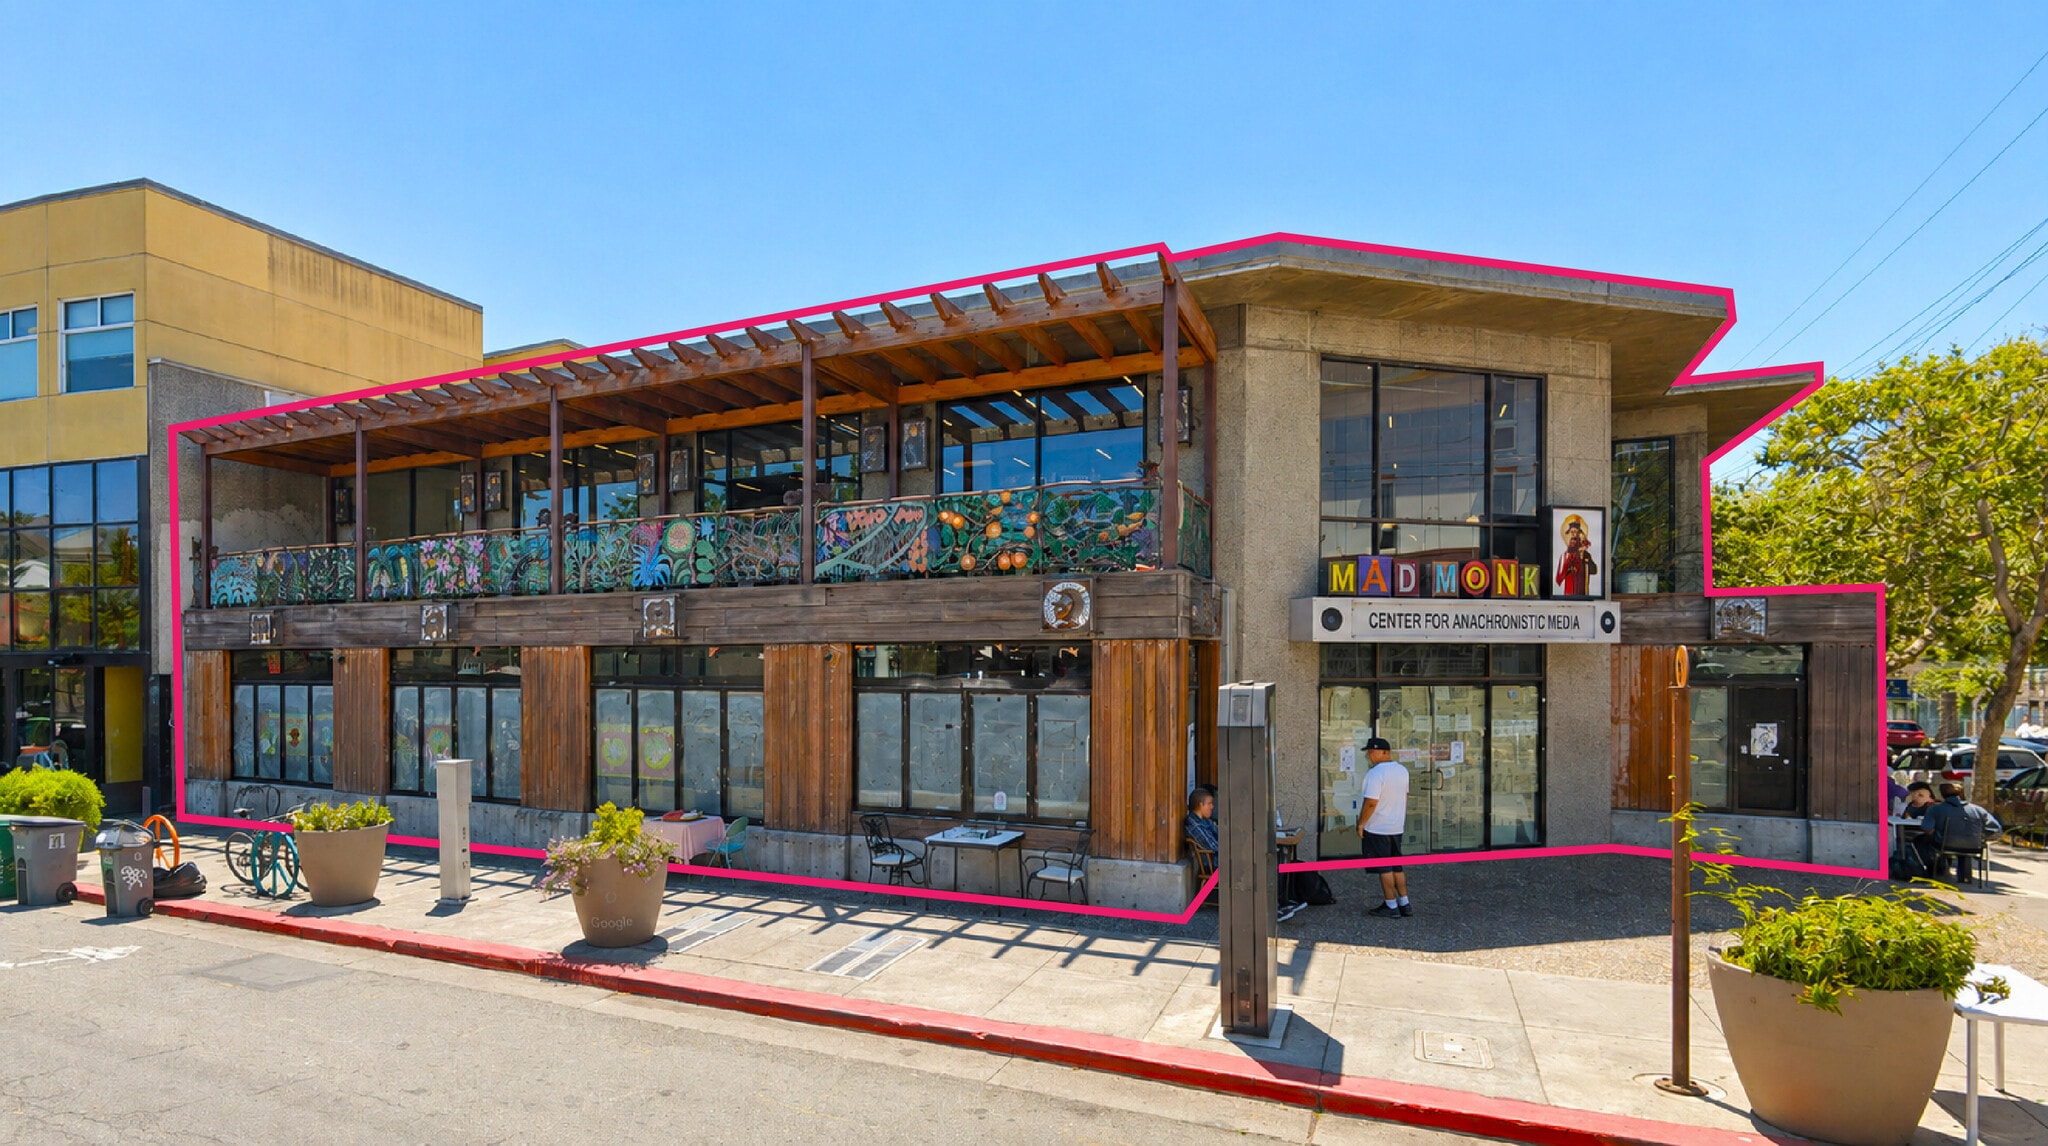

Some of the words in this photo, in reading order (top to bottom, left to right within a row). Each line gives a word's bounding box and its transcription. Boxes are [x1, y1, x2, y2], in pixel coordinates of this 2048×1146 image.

[1331, 558, 1417, 593] MAD
[1434, 563, 1540, 597] MONK
[1368, 612, 1422, 630] CENTER
[1424, 613, 1450, 630] FOR
[1452, 613, 1546, 630] ANACHRONISTIC
[1547, 614, 1581, 631] MEDIA
